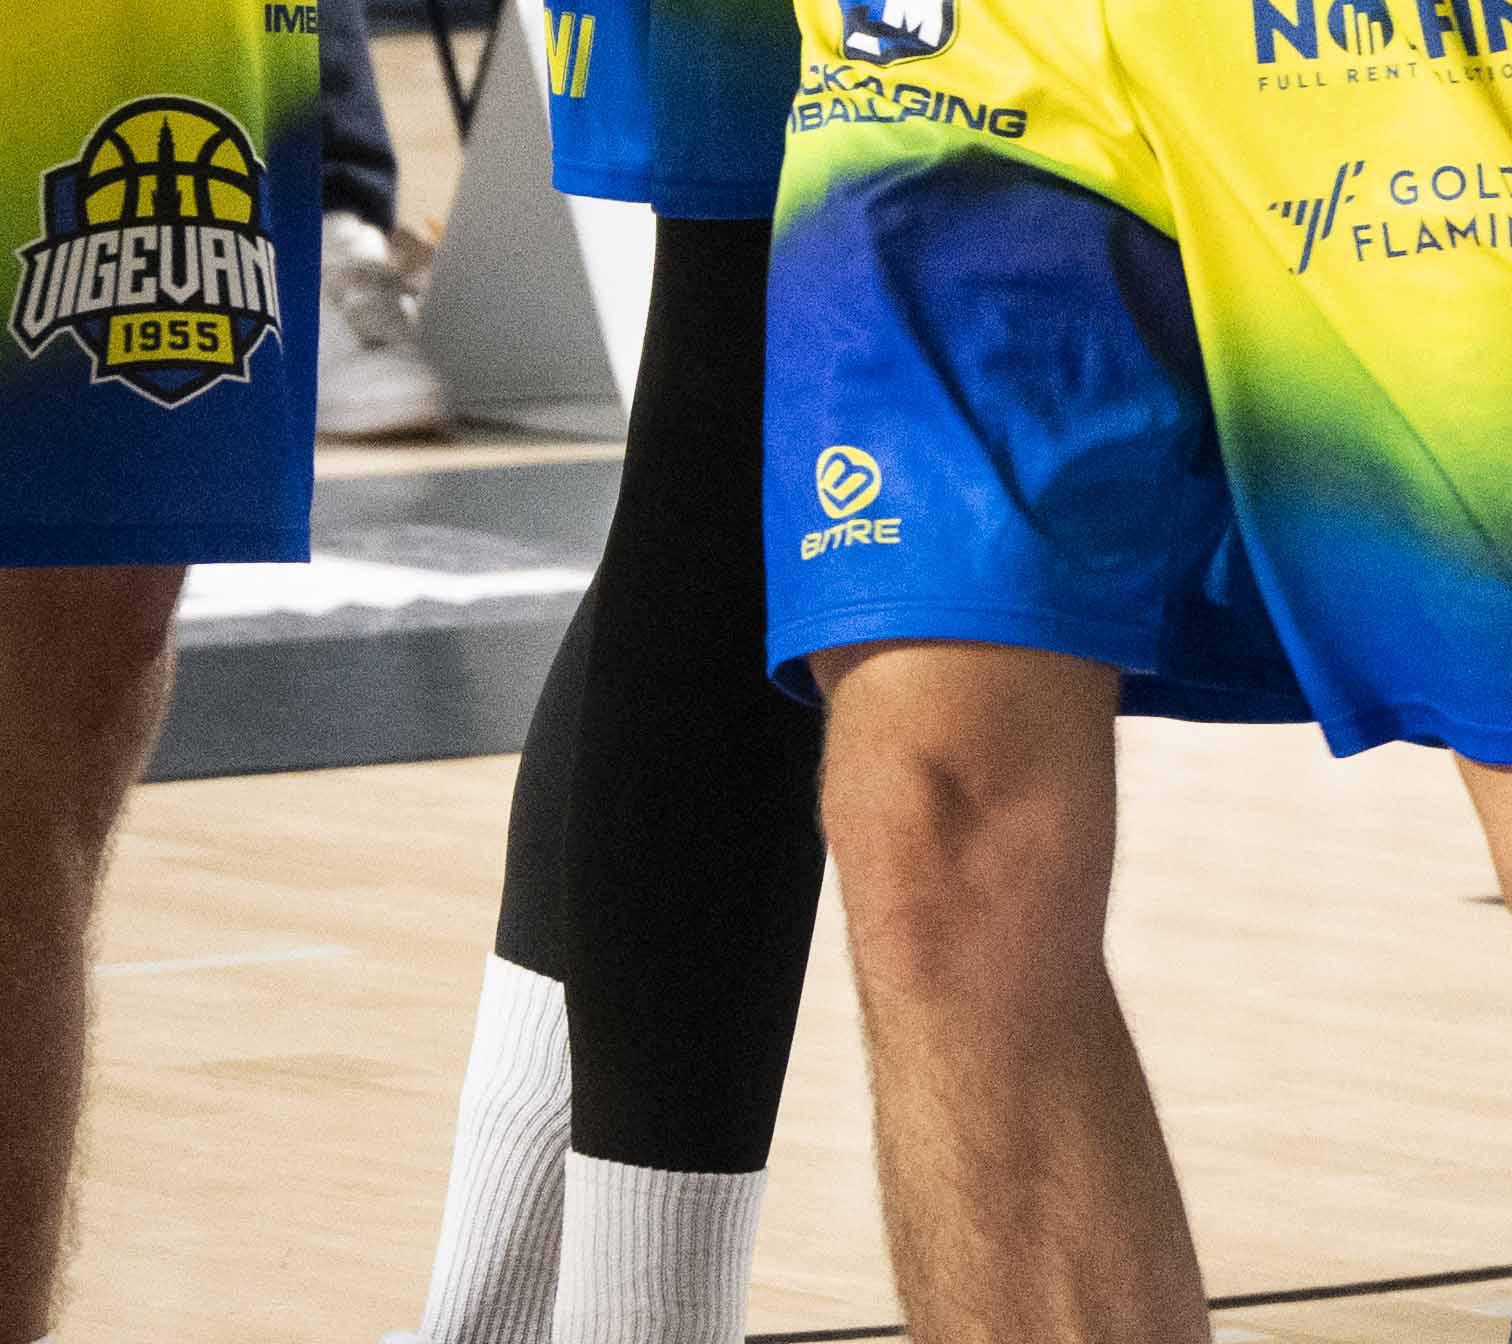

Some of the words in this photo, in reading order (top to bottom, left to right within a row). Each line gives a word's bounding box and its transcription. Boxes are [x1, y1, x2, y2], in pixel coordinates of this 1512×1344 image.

[1258, 74, 1328, 92] FULL
[1347, 64, 1417, 83] RENT
[25, 224, 281, 340] VIGEVAN
[122, 318, 220, 354] 1955
[801, 518, 902, 561] BITRE
